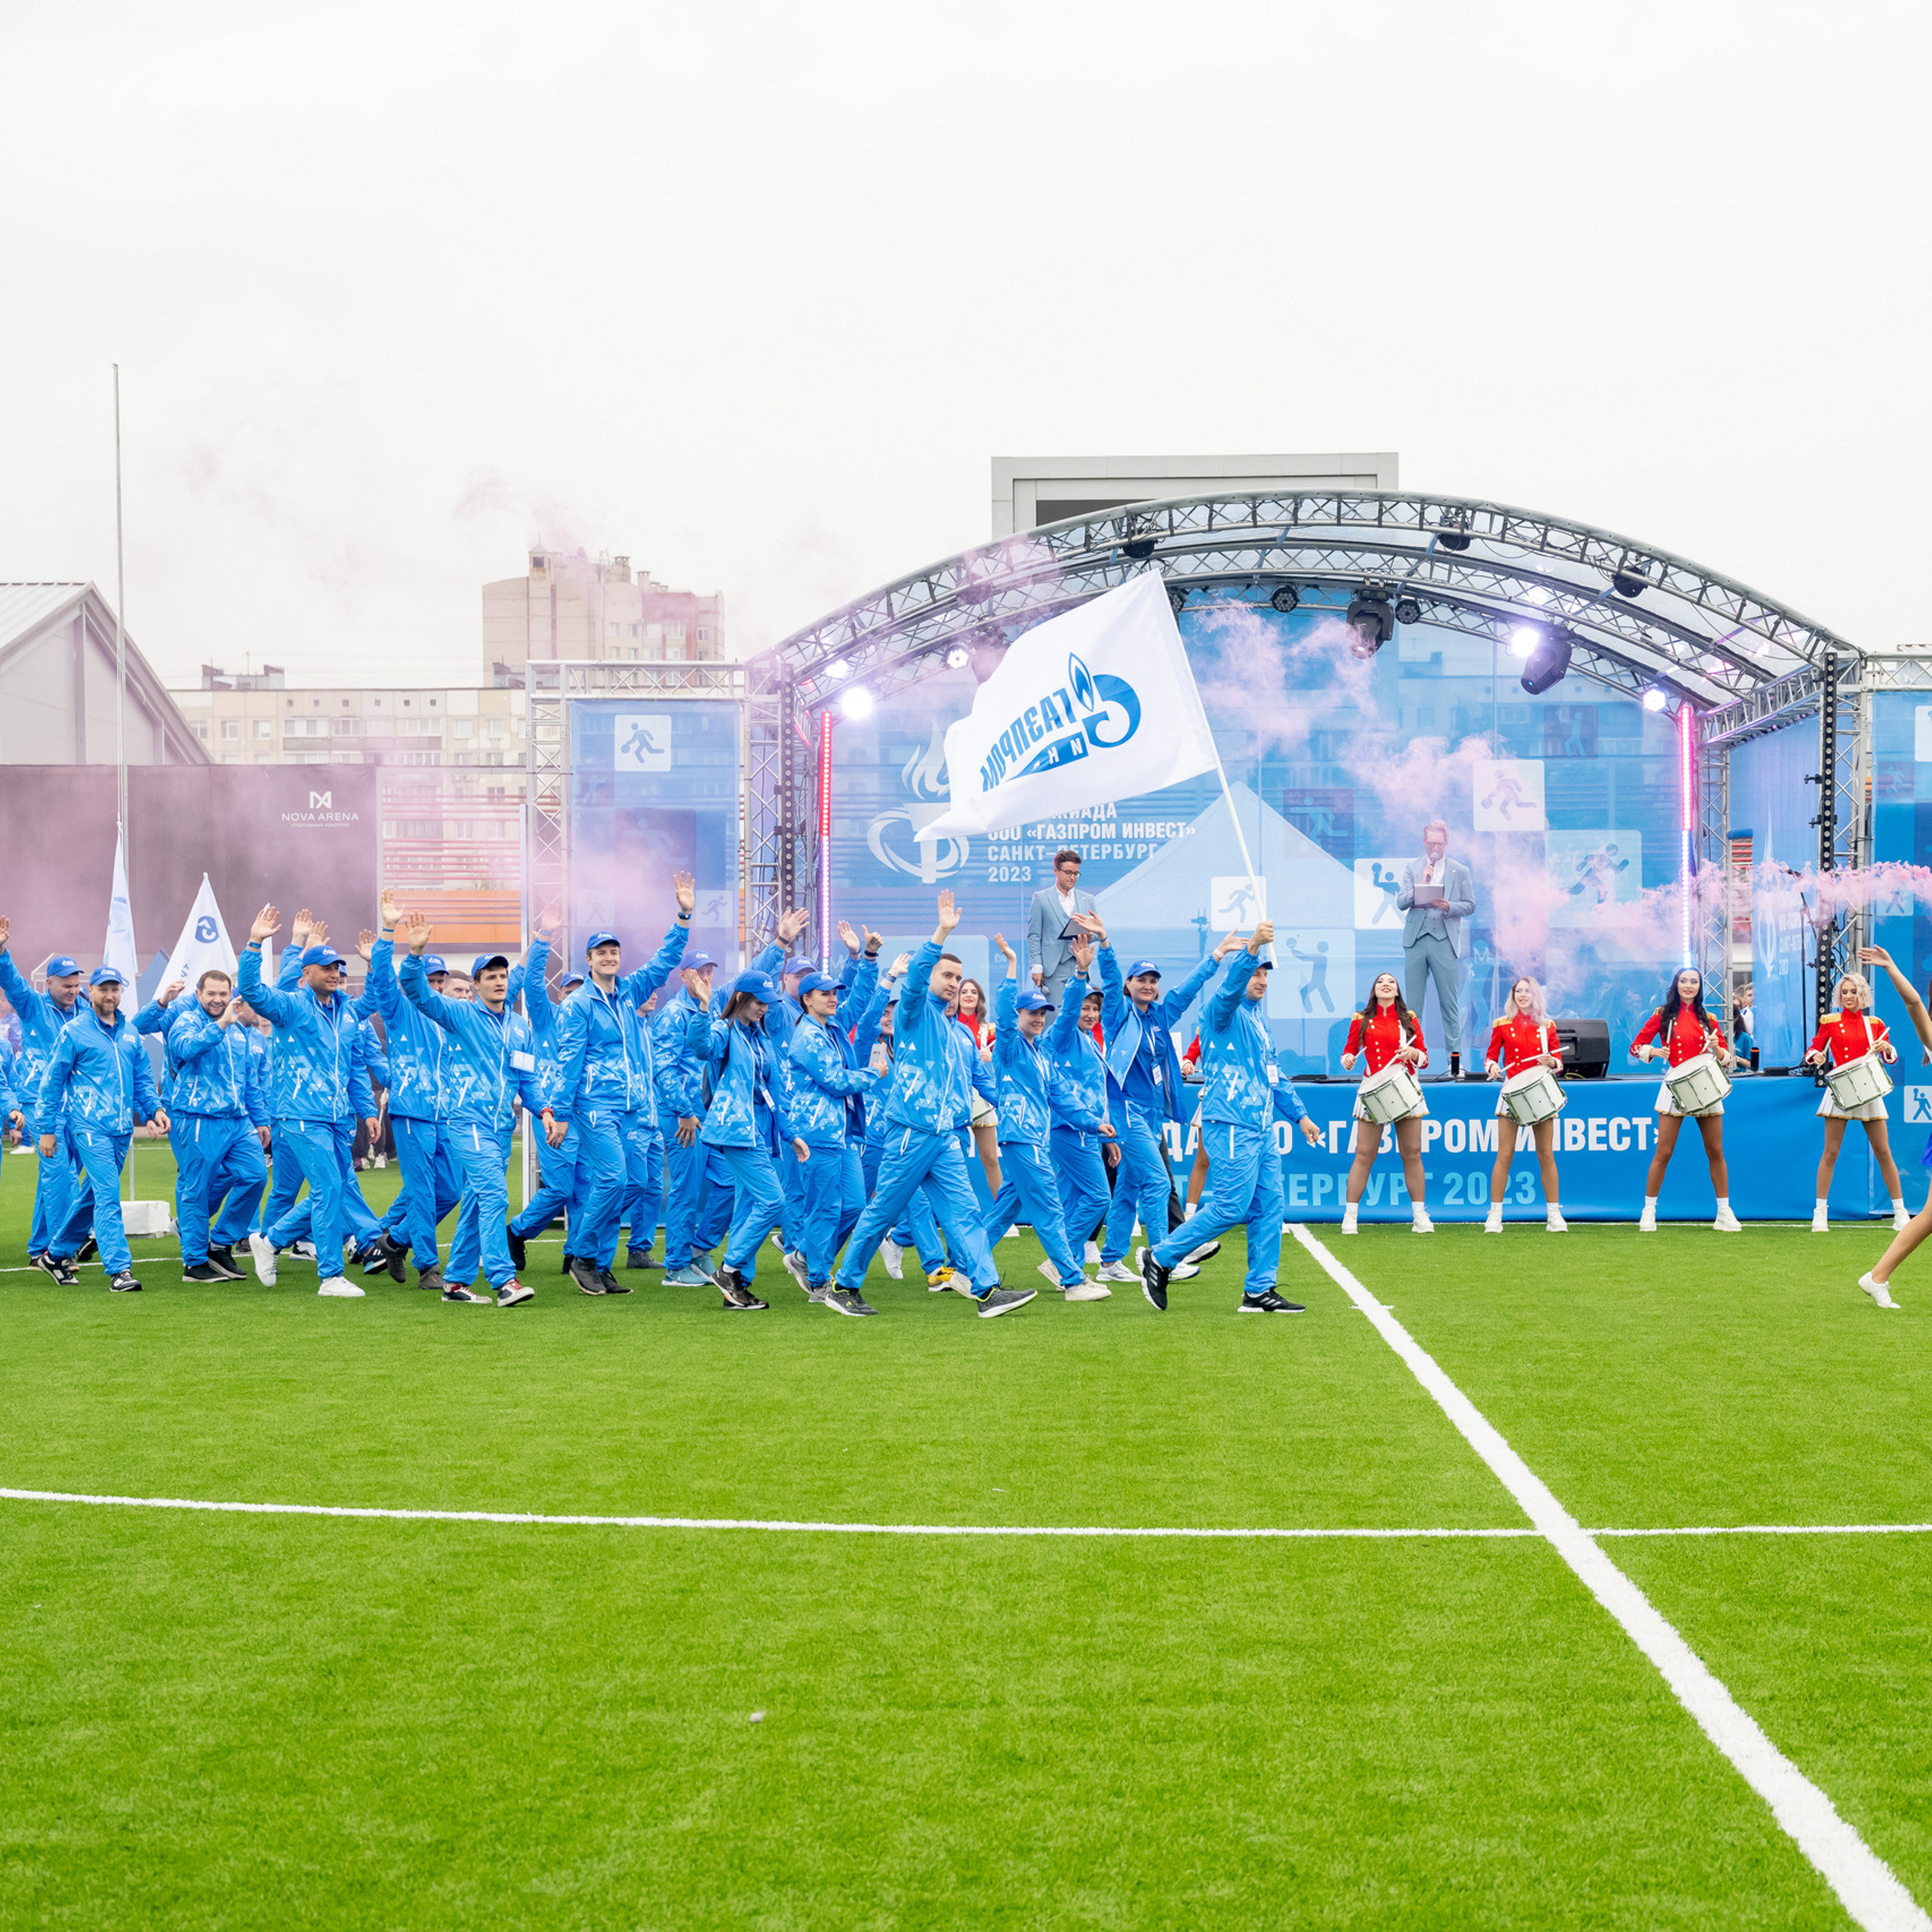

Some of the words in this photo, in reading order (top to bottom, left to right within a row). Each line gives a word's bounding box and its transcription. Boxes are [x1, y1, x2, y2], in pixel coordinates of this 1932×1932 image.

[281, 812, 315, 822] NOVA
[317, 812, 359, 821] ARENA
[1026, 823, 1116, 840] «ГАЗПРОМ
[1122, 822, 1196, 839] ИНВЕСТ»
[988, 866, 1032, 882] 2023
